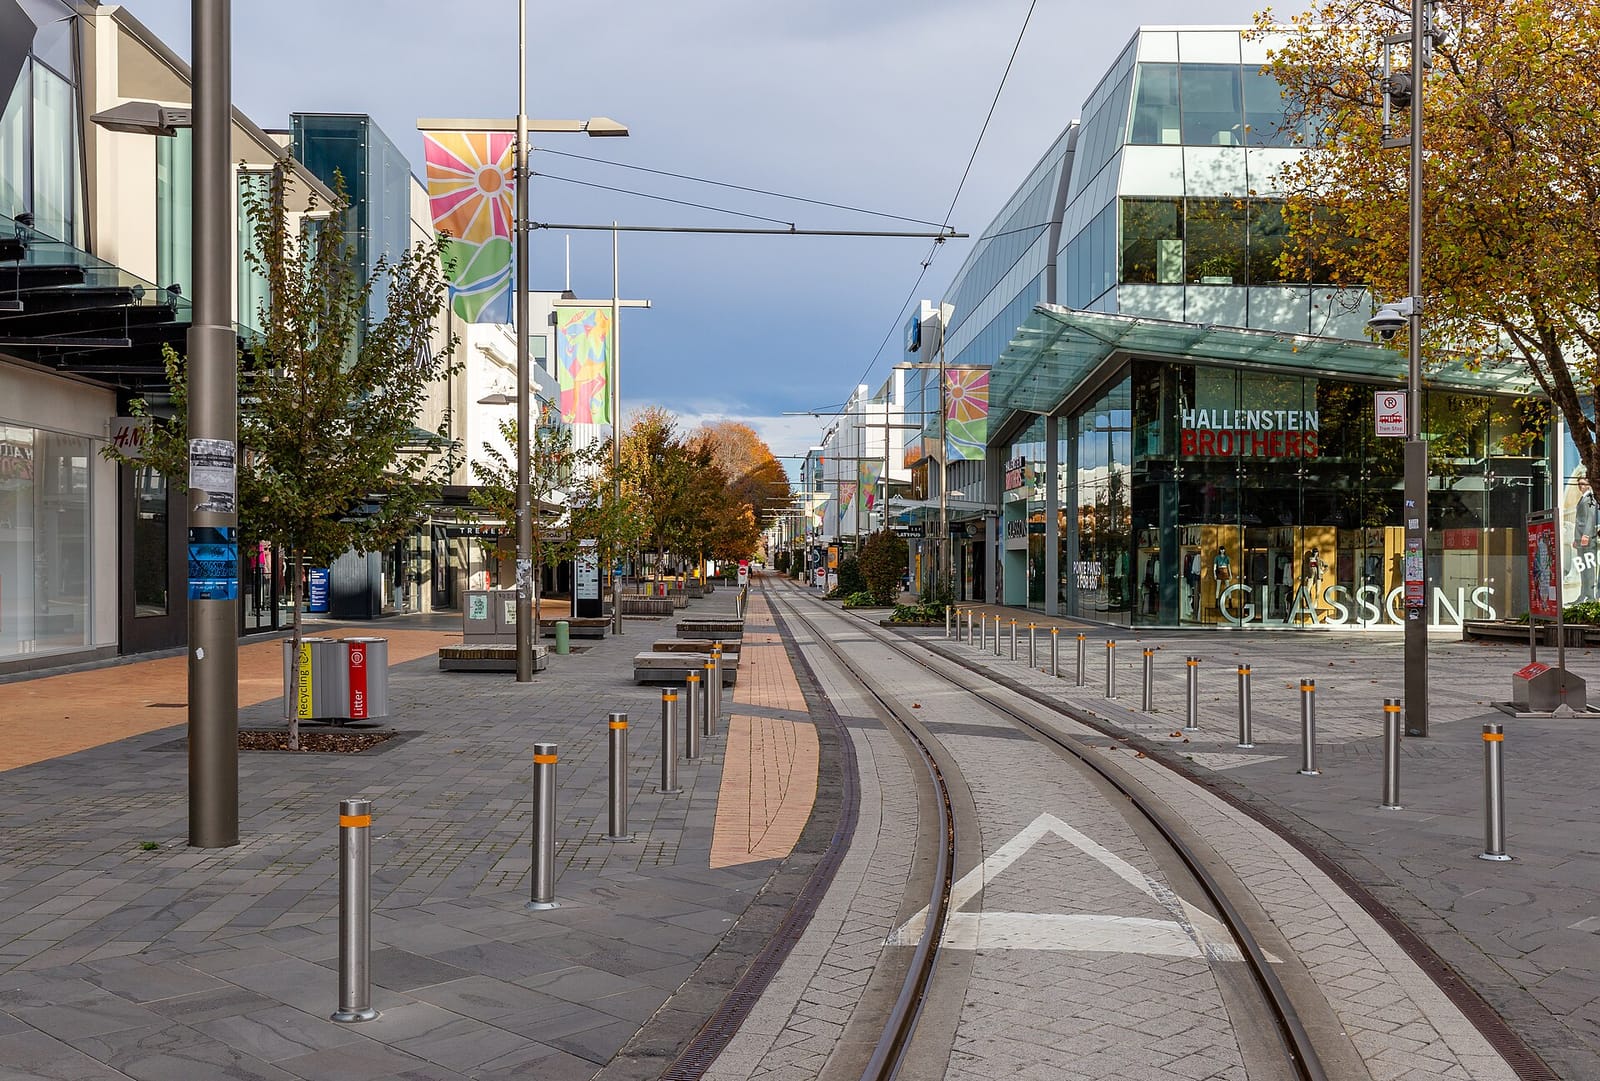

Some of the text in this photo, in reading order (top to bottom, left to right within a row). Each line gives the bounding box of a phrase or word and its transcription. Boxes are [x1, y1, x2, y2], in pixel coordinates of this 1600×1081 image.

[1182, 408, 1319, 431] HALLENSTEIN
[1181, 429, 1319, 456] BROTHERS
[298, 670, 310, 716] Recycling
[353, 690, 364, 716] Litter
